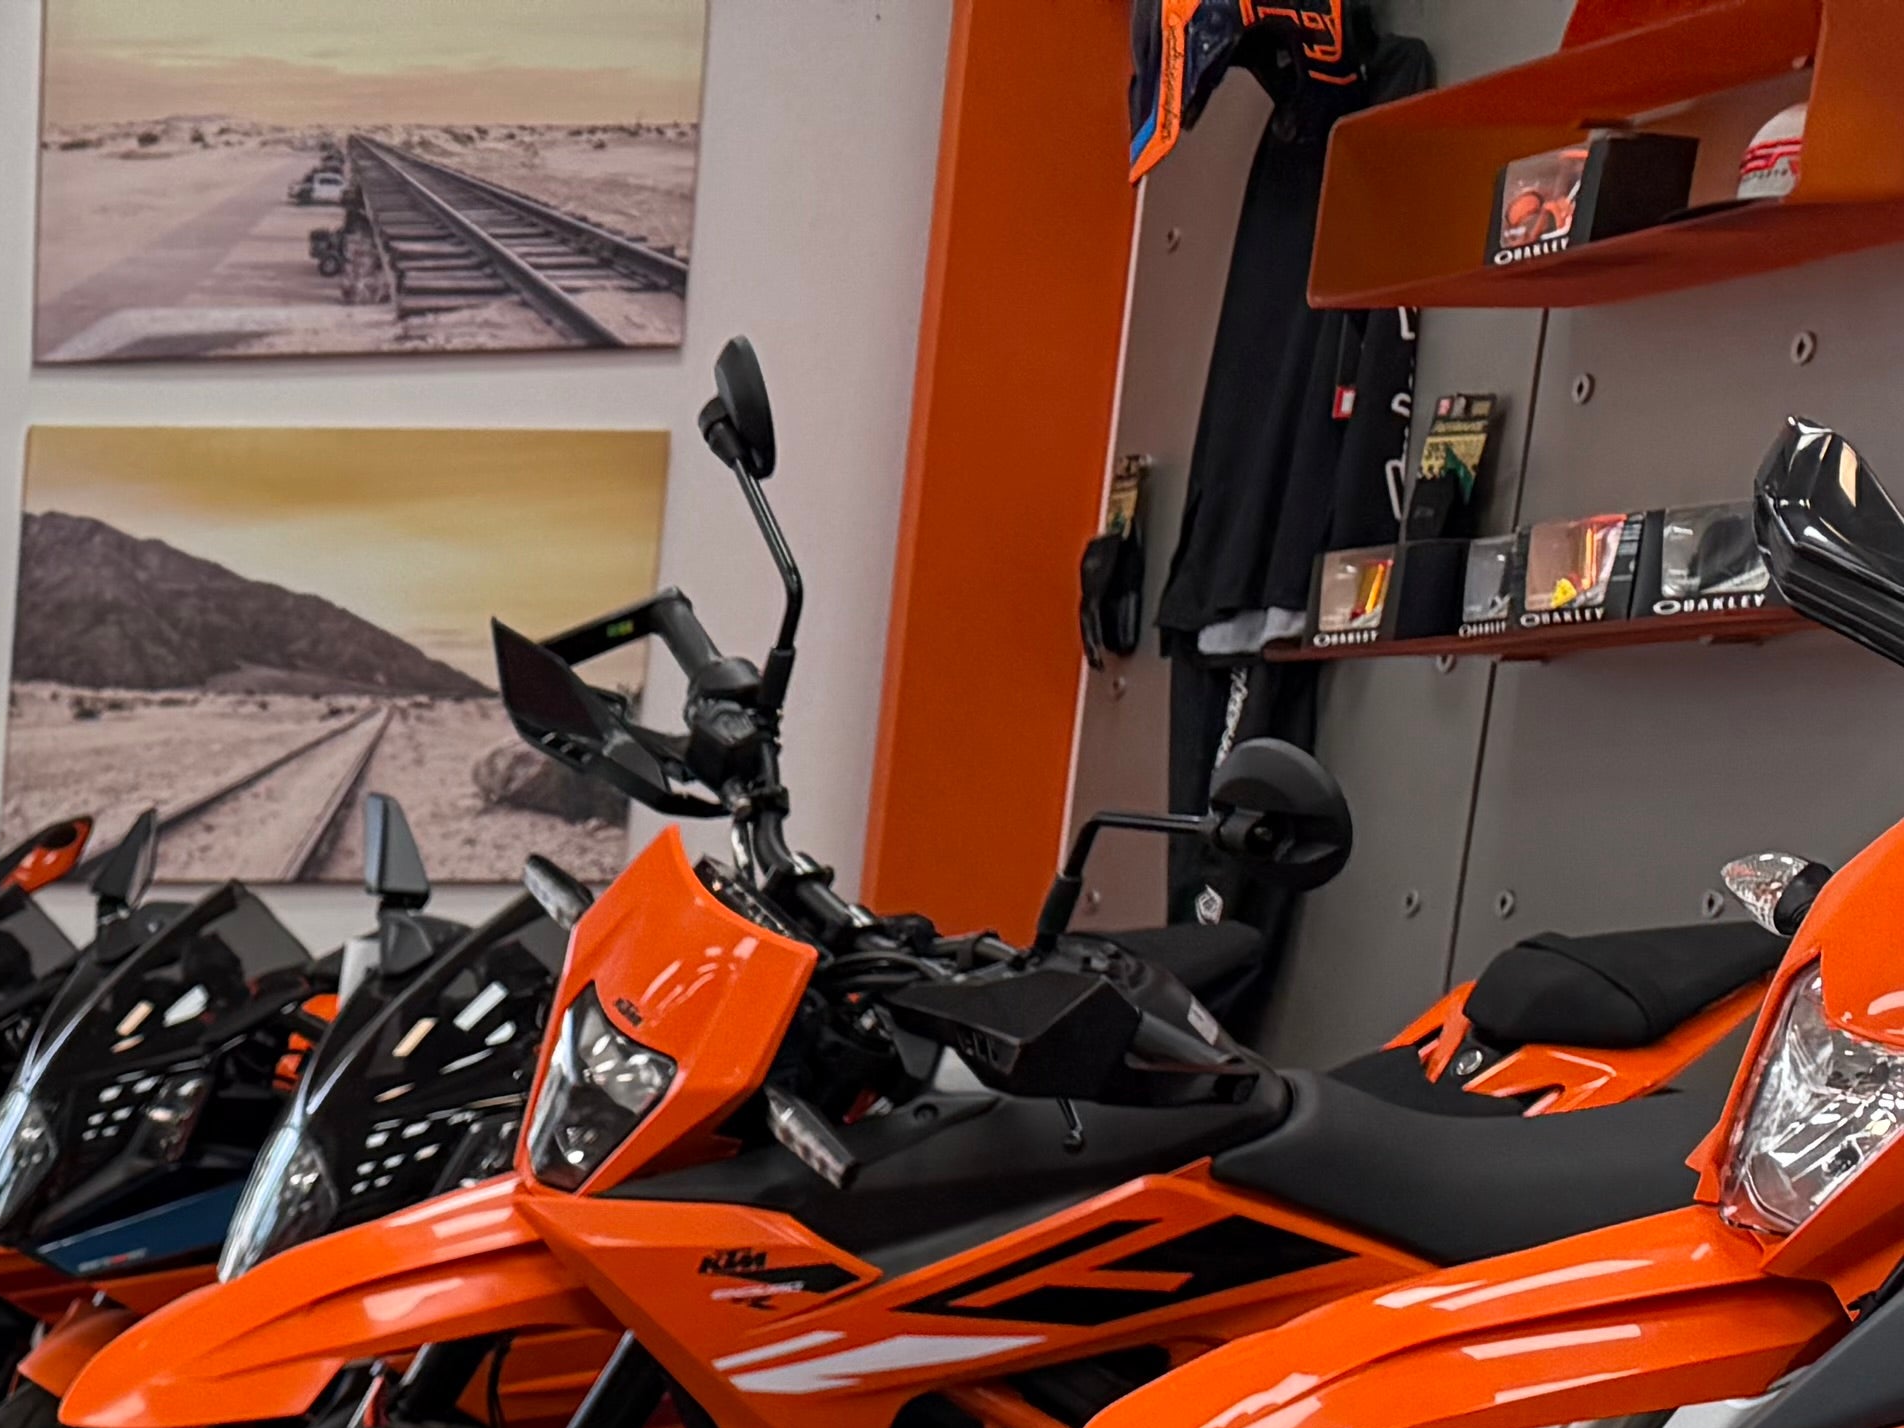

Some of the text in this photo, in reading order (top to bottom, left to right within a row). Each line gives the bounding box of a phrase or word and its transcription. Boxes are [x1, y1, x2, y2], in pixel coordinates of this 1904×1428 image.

[1493, 237, 1570, 265] OAKLEY
[1652, 593, 1766, 615] OAKLEY
[1520, 607, 1604, 628] OAKLEY
[698, 1247, 768, 1275] KTM
